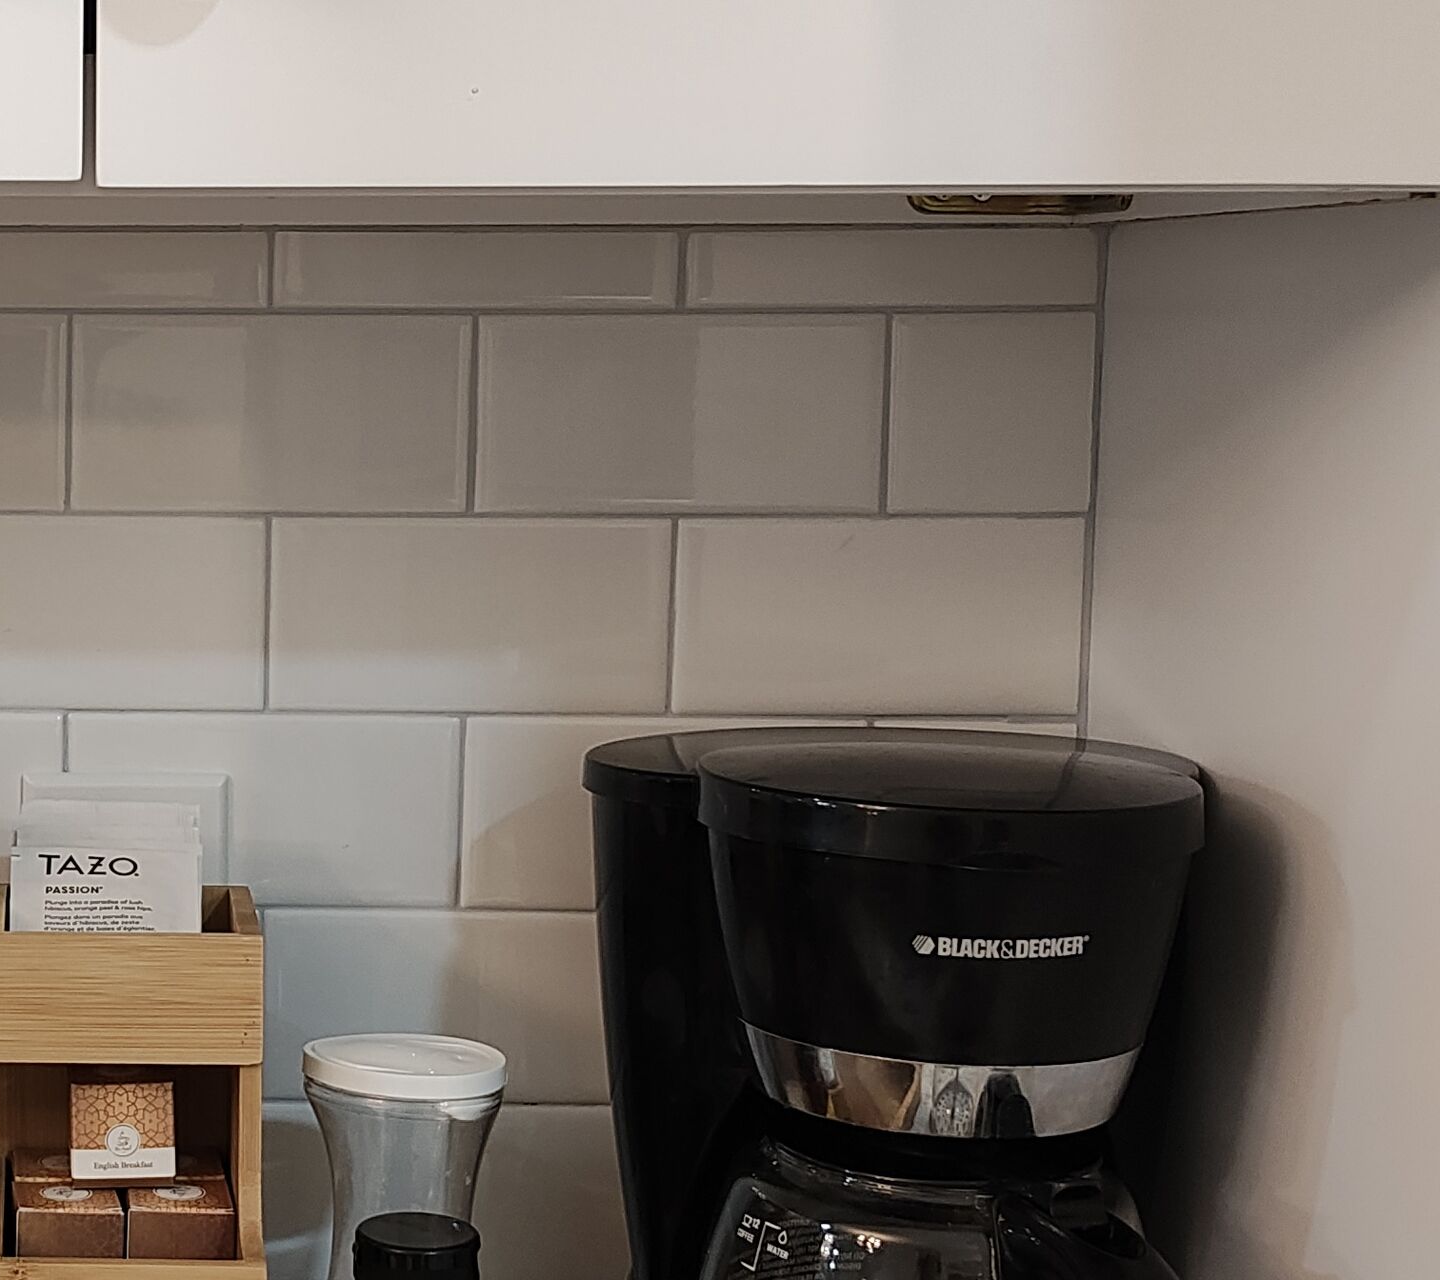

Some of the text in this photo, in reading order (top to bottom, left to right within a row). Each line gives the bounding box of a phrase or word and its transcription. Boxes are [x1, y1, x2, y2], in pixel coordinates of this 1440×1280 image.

[93, 1161, 153, 1170] English Breakfast
[752, 1218, 761, 1230] 12
[736, 1227, 755, 1244] COFFEE
[766, 1243, 789, 1260] WATER
